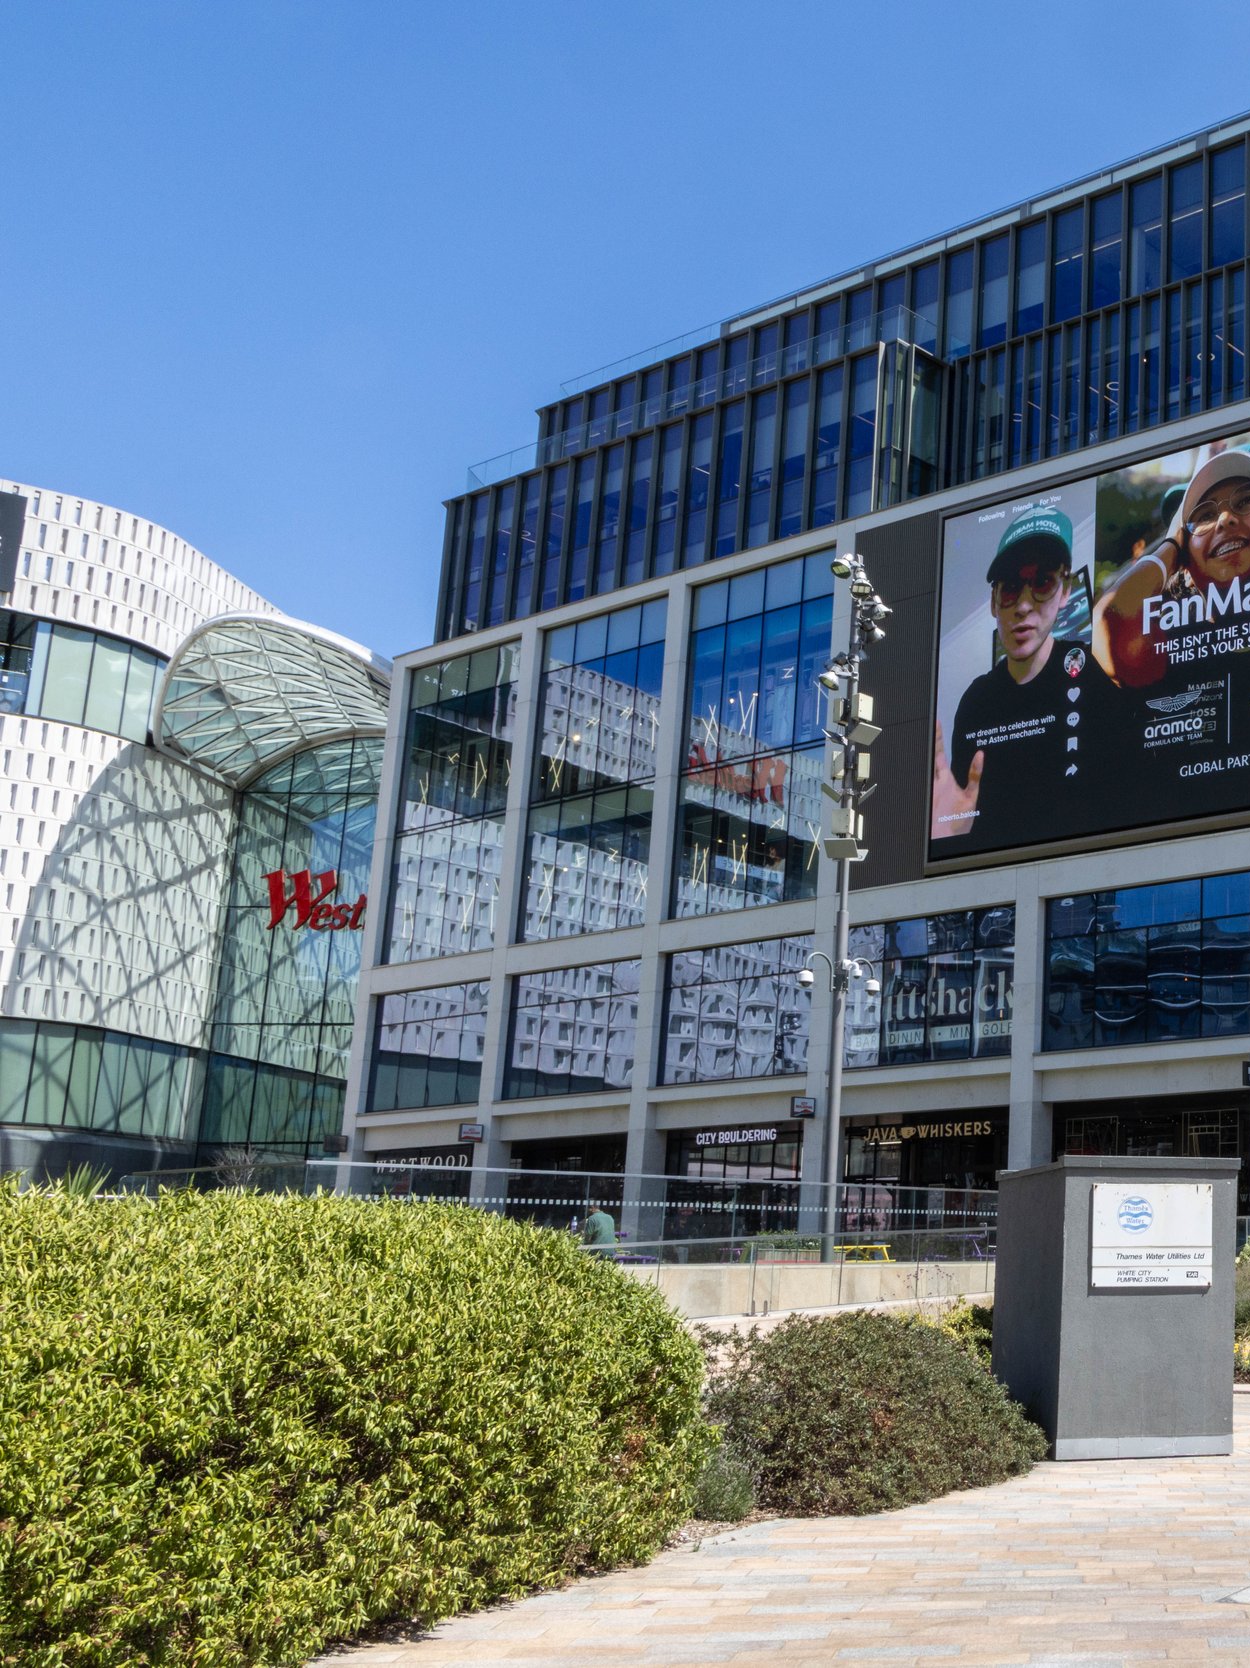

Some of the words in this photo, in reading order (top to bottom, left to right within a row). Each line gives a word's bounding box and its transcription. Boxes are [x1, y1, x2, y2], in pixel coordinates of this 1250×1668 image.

[1012, 502, 1033, 513] Friends
[1040, 498, 1049, 506] For
[1050, 495, 1061, 503] You
[979, 511, 1005, 523] Following
[1154, 637, 1179, 655] THIS
[1182, 631, 1212, 651] ISN'T
[1215, 625, 1244, 643] THE
[1169, 649, 1195, 665] THIS
[1198, 647, 1208, 660] IS
[1212, 640, 1244, 657] YOUR
[976, 727, 999, 738] dream
[999, 725, 1007, 733] to
[1007, 718, 1040, 731] celebrate
[1040, 714, 1056, 724] with
[1144, 717, 1203, 739] aramco
[976, 738, 988, 747] the
[988, 734, 1009, 745] Aston
[1009, 726, 1046, 740] mechanics
[1143, 738, 1171, 749] FORMULA
[1187, 732, 1203, 741] TEAM
[1179, 759, 1225, 778] GLOBAL
[260, 869, 367, 931] West
[890, 1030, 922, 1045] DININ
[950, 1025, 970, 1039] MIN
[982, 1021, 1013, 1036] GOLF
[696, 1132, 716, 1145] CITY
[718, 1128, 777, 1144] BOULDERING
[864, 1127, 898, 1141] JAVA
[917, 1121, 992, 1139] WHISKERS
[375, 1154, 468, 1174] WESTWOOD
[1145, 1252, 1165, 1260] Water
[1167, 1252, 1191, 1260] Utilities
[1193, 1252, 1205, 1260] Ltd
